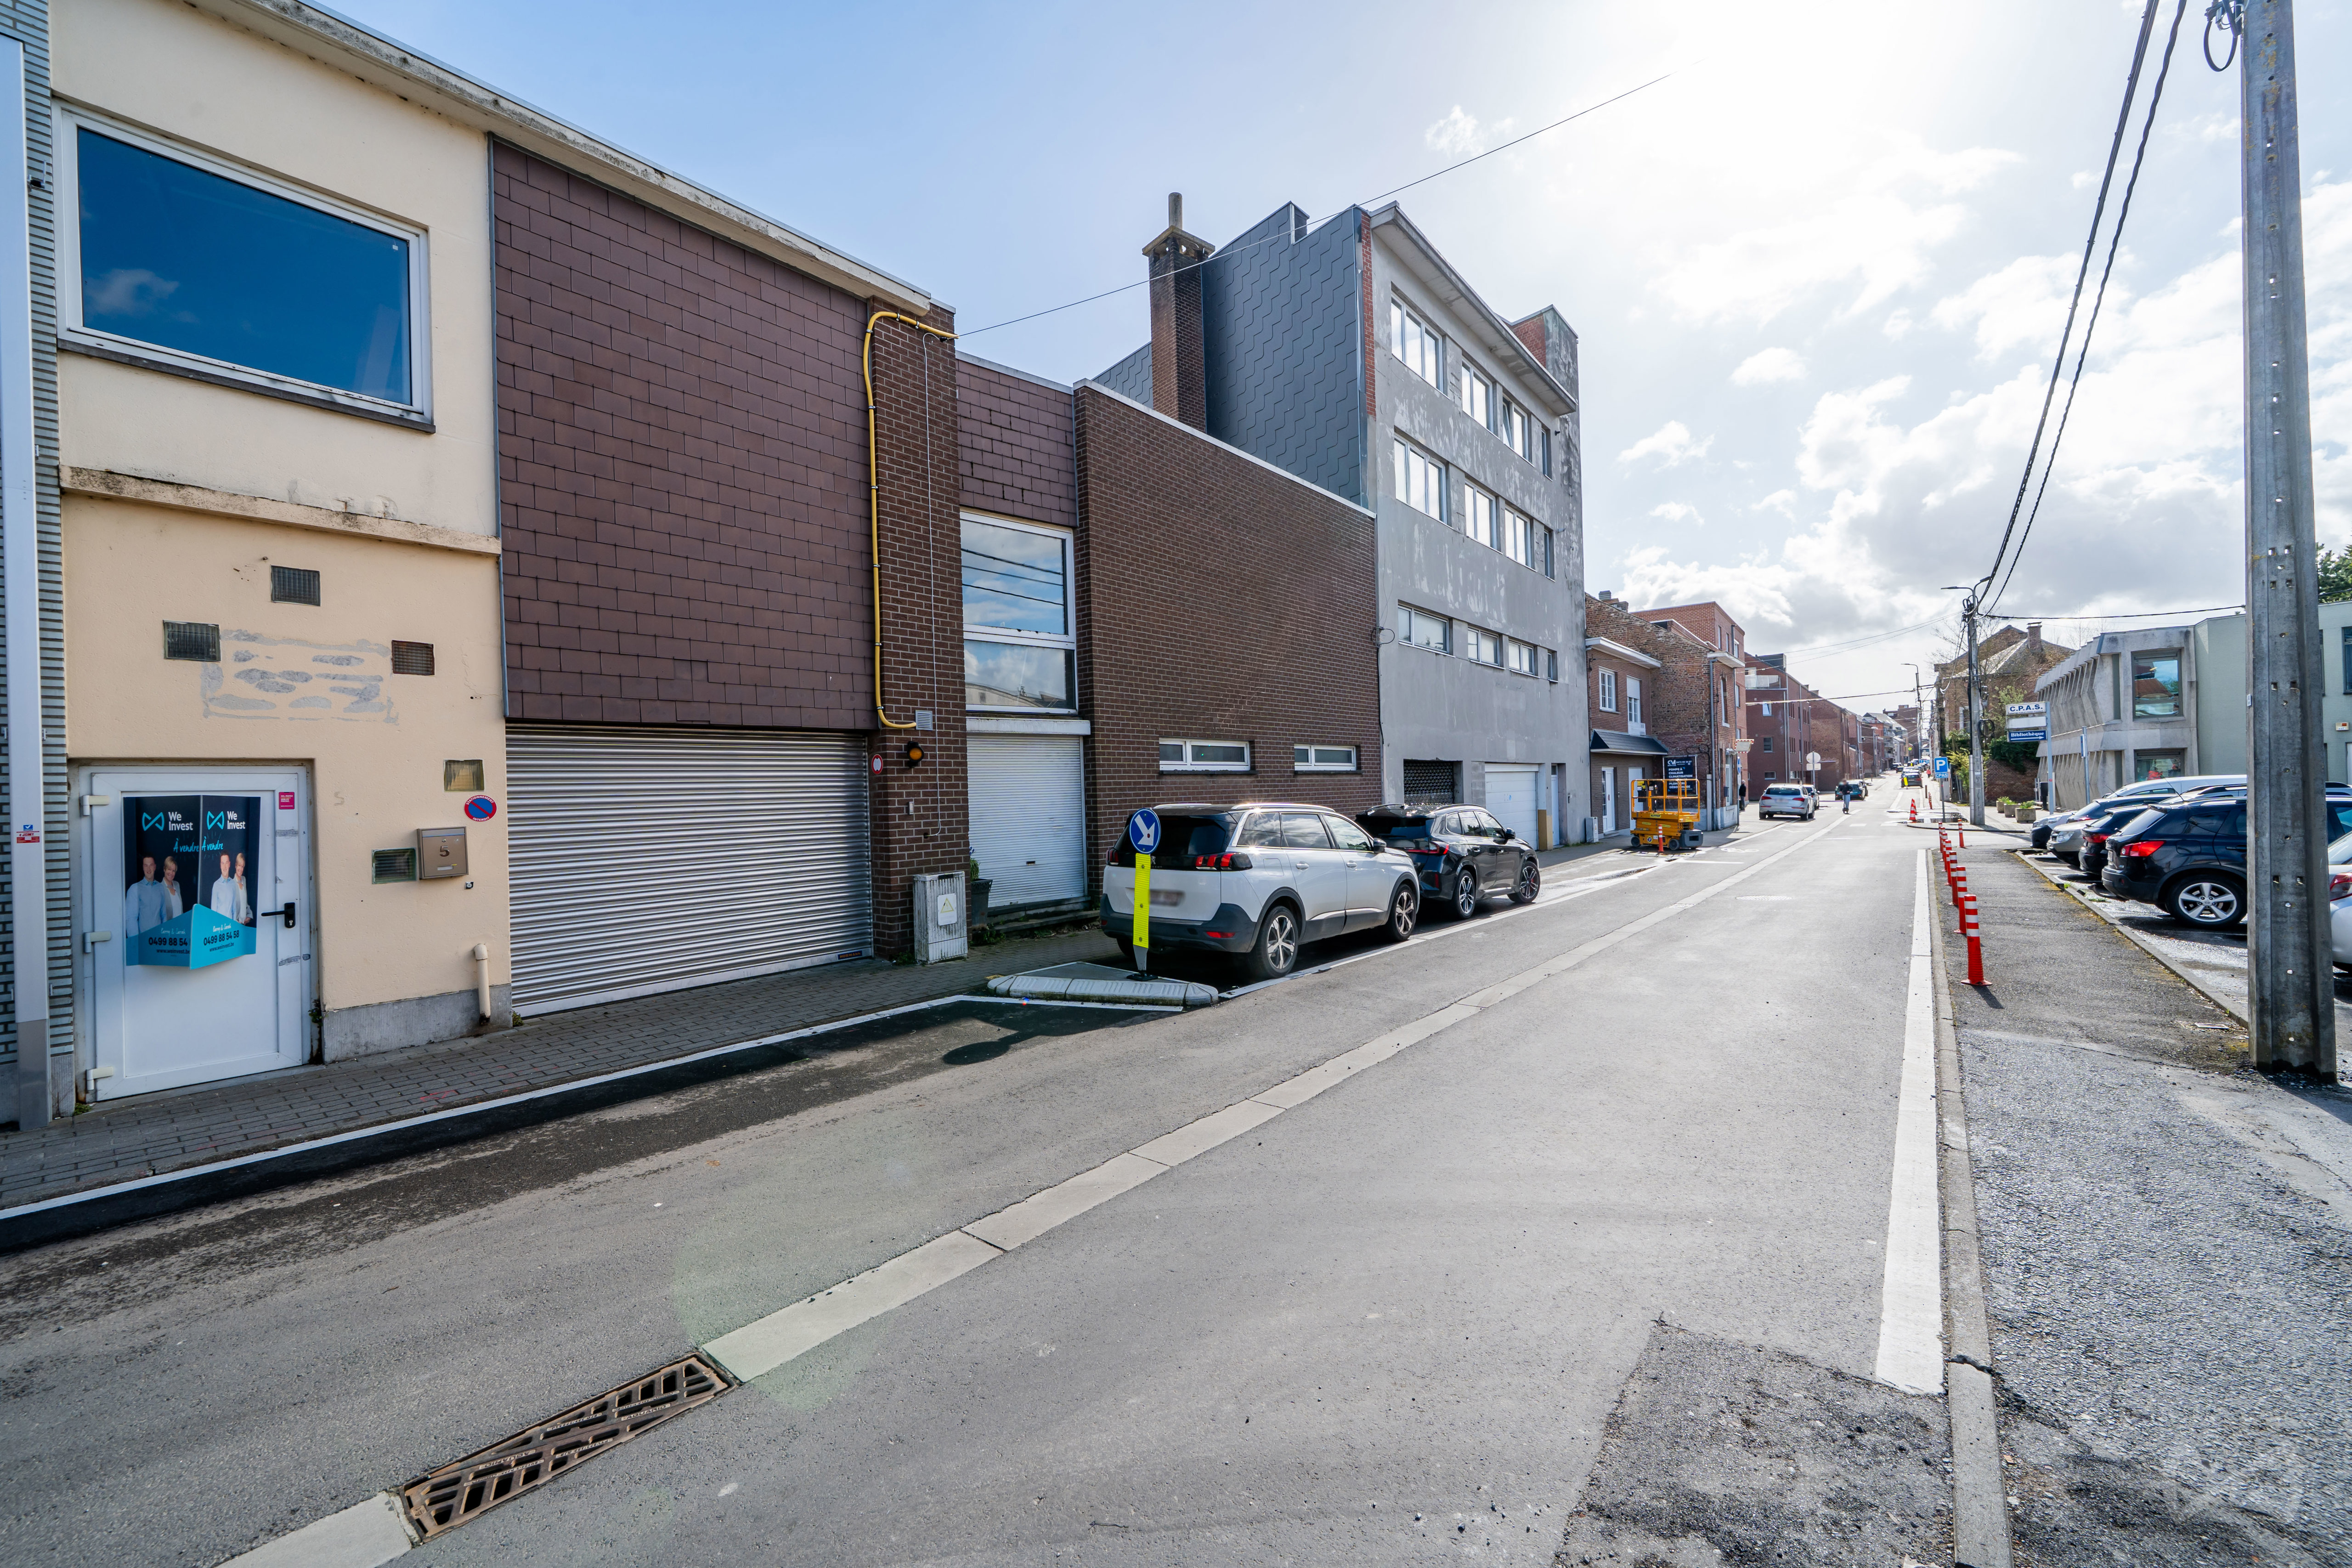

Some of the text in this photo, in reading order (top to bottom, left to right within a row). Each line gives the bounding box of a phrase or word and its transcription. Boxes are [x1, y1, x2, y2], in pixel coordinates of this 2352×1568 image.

[1936, 759, 1945, 770] P
[466, 795, 494, 805] STATIONNEMENT
[168, 811, 182, 821] We
[227, 811, 237, 820] We
[169, 821, 193, 831] Invest
[227, 820, 246, 830] Invest
[173, 838, 199, 853] À vendre
[202, 836, 223, 852] À vendre
[440, 845, 450, 857] 5
[148, 937, 167, 946] 0499
[169, 938, 177, 946] 88
[179, 938, 188, 946] 54
[204, 930, 239, 946] 0499 88 54 58
[209, 941, 234, 952] www.weinvest.be
[627, 1405, 666, 1419] AQUARIO
[485, 1452, 529, 1467] AQUARIO
